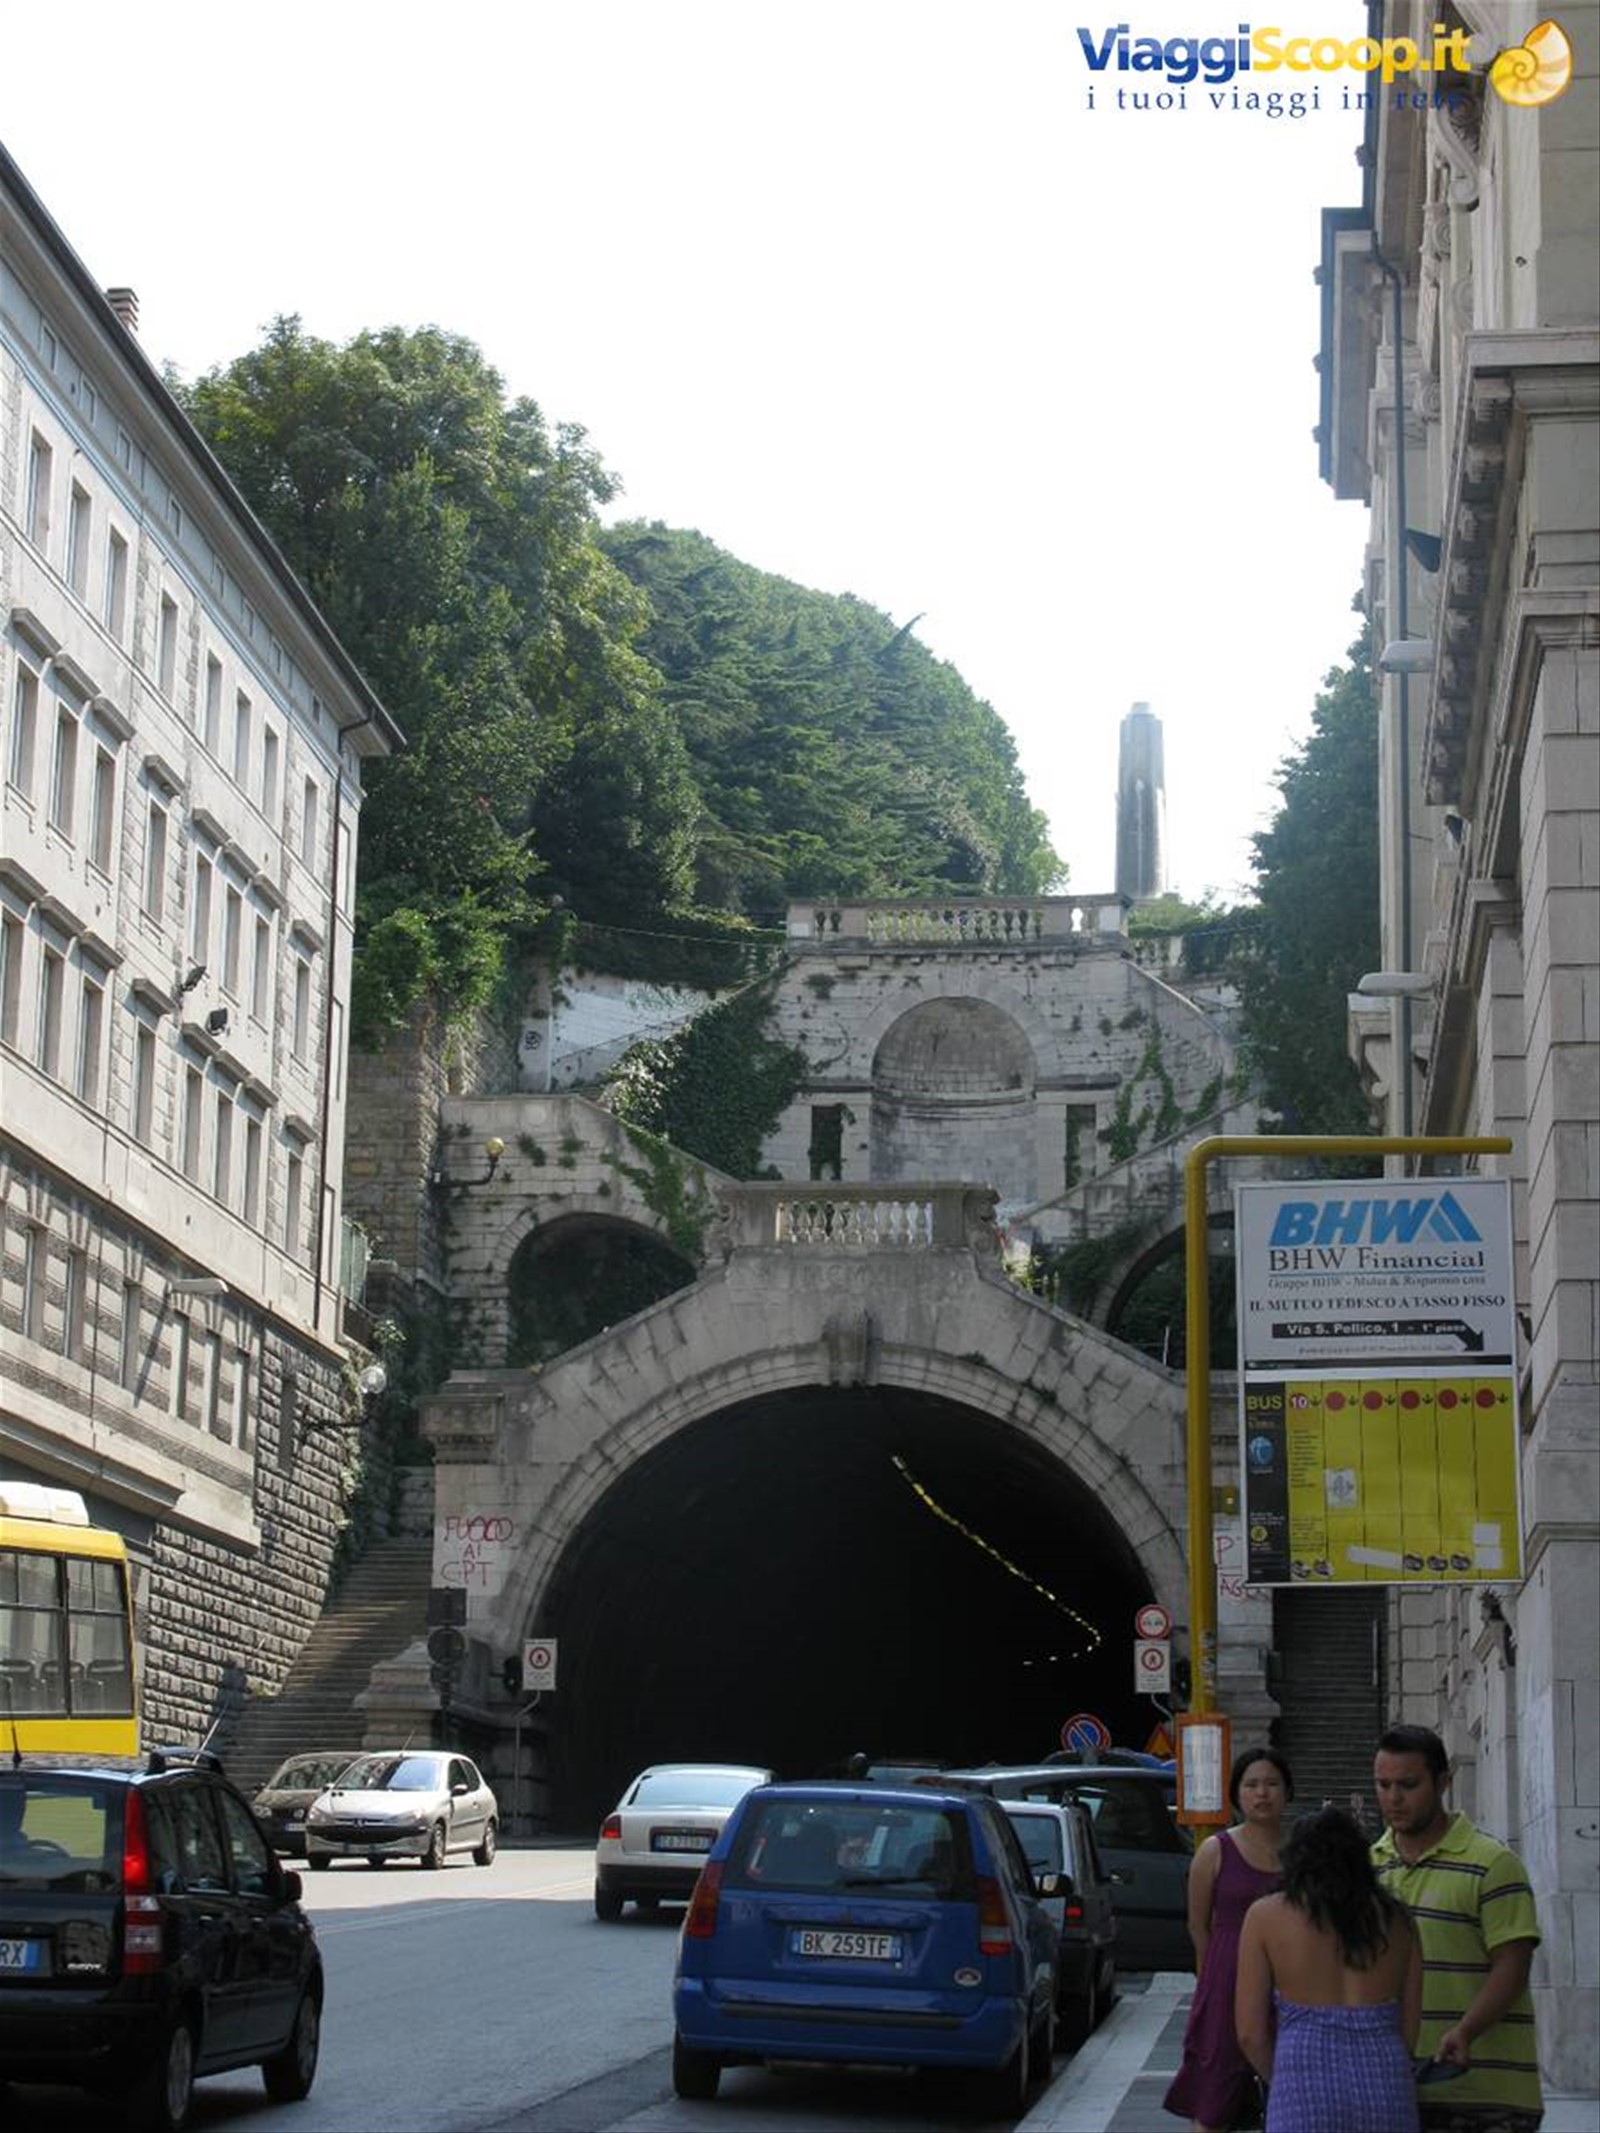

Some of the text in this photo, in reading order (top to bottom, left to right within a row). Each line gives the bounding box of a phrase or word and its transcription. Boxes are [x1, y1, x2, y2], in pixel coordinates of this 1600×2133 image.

[1269, 1247, 1485, 1271] BHW Financial
[1267, 1300, 1323, 1311] MUTUO
[1328, 1297, 1396, 1309] TEDESCO
[1399, 1297, 1410, 1308] A
[1413, 1296, 1460, 1308] TASSO
[1463, 1295, 1506, 1307] FISSO
[1287, 1324, 1311, 1335] Via
[1315, 1324, 1330, 1334] S.
[1333, 1322, 1387, 1334] Pellico,
[1391, 1322, 1399, 1333] 1
[1247, 1395, 1282, 1410] BUS
[1291, 1396, 1308, 1409] 10
[803, 1933, 889, 1956] BK 259TF
